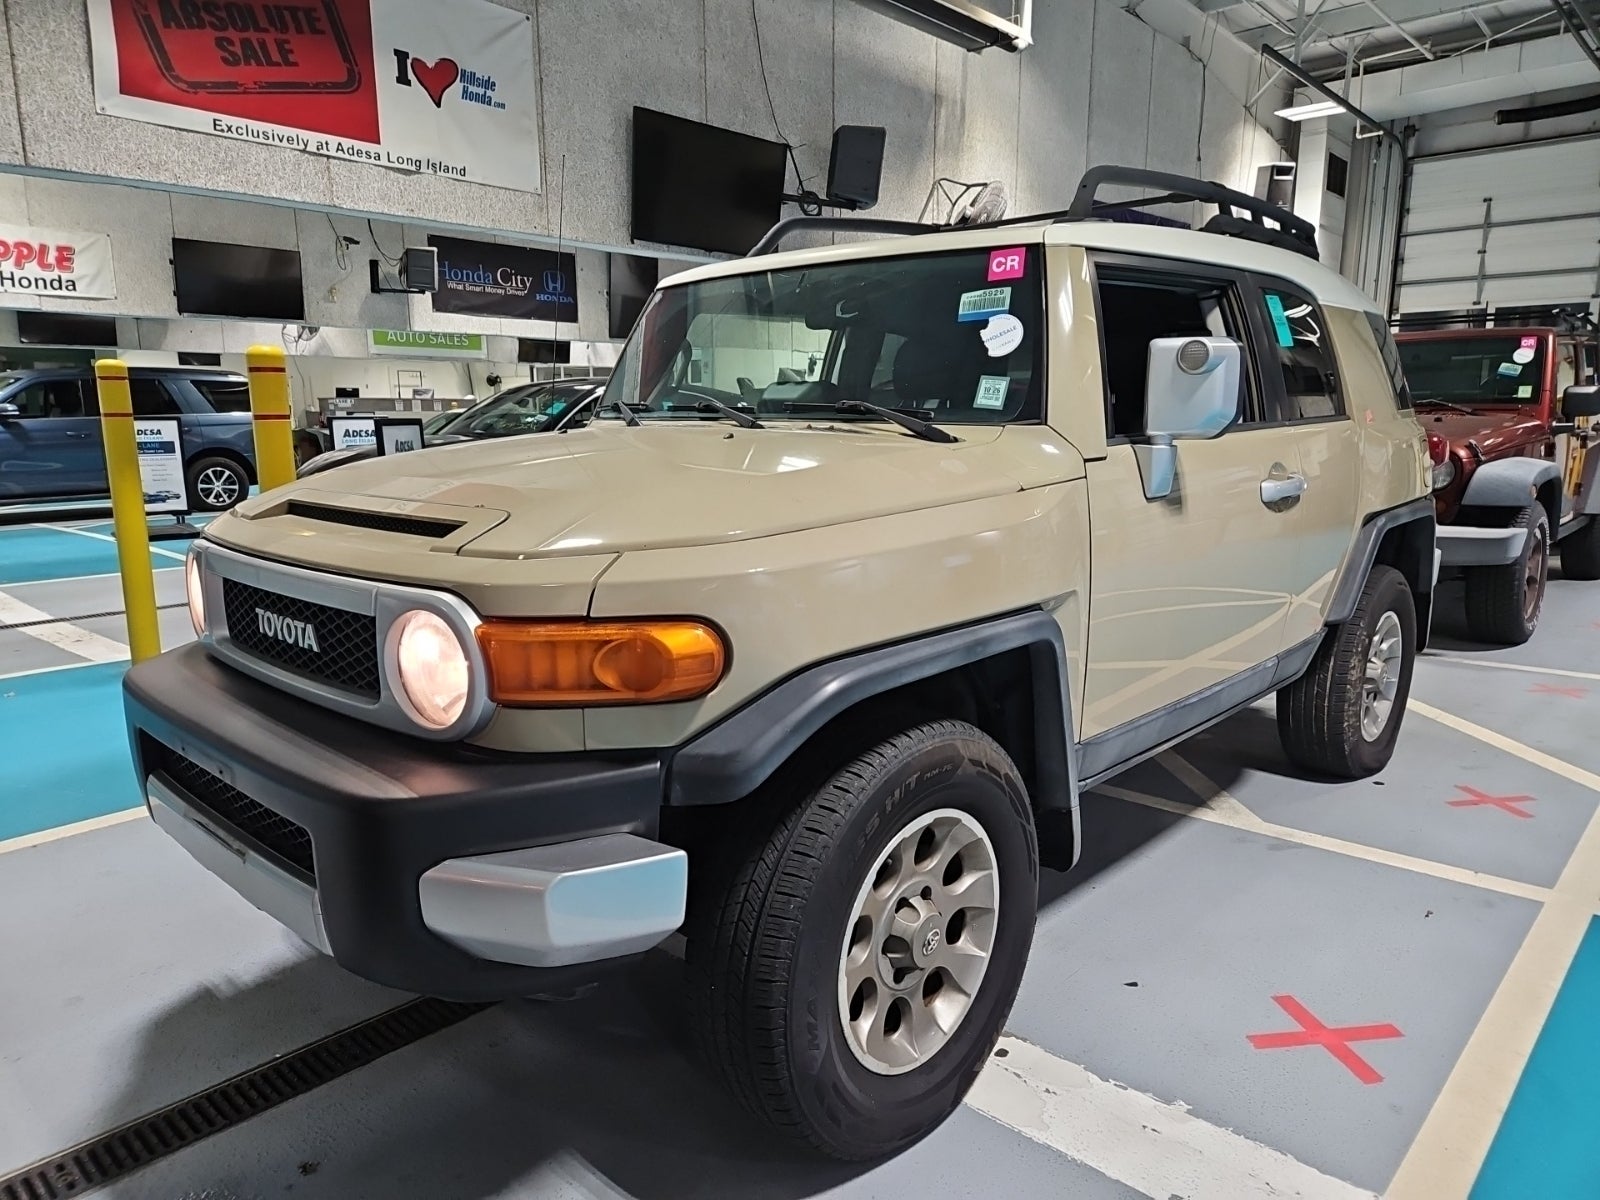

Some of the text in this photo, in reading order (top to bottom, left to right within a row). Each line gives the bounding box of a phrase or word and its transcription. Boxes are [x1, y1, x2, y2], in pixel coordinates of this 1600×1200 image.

[158, 0, 326, 35] ABSOLUTE
[214, 36, 299, 67] SALE
[393, 48, 411, 87] I
[460, 68, 496, 92] Hillside
[213, 118, 467, 177] Exclusively at Adesa Long Island
[992, 255, 1019, 273] CR
[0, 270, 77, 292] Honda
[447, 281, 464, 290] What
[465, 283, 484, 292] Smart
[485, 285, 505, 295] Money
[497, 267, 533, 294] City
[536, 293, 575, 304] HONDA
[387, 330, 469, 346] AUTO SALES
[1522, 338, 1535, 347] CR
[137, 428, 162, 436] DESA
[255, 607, 320, 653] TOYOTA
